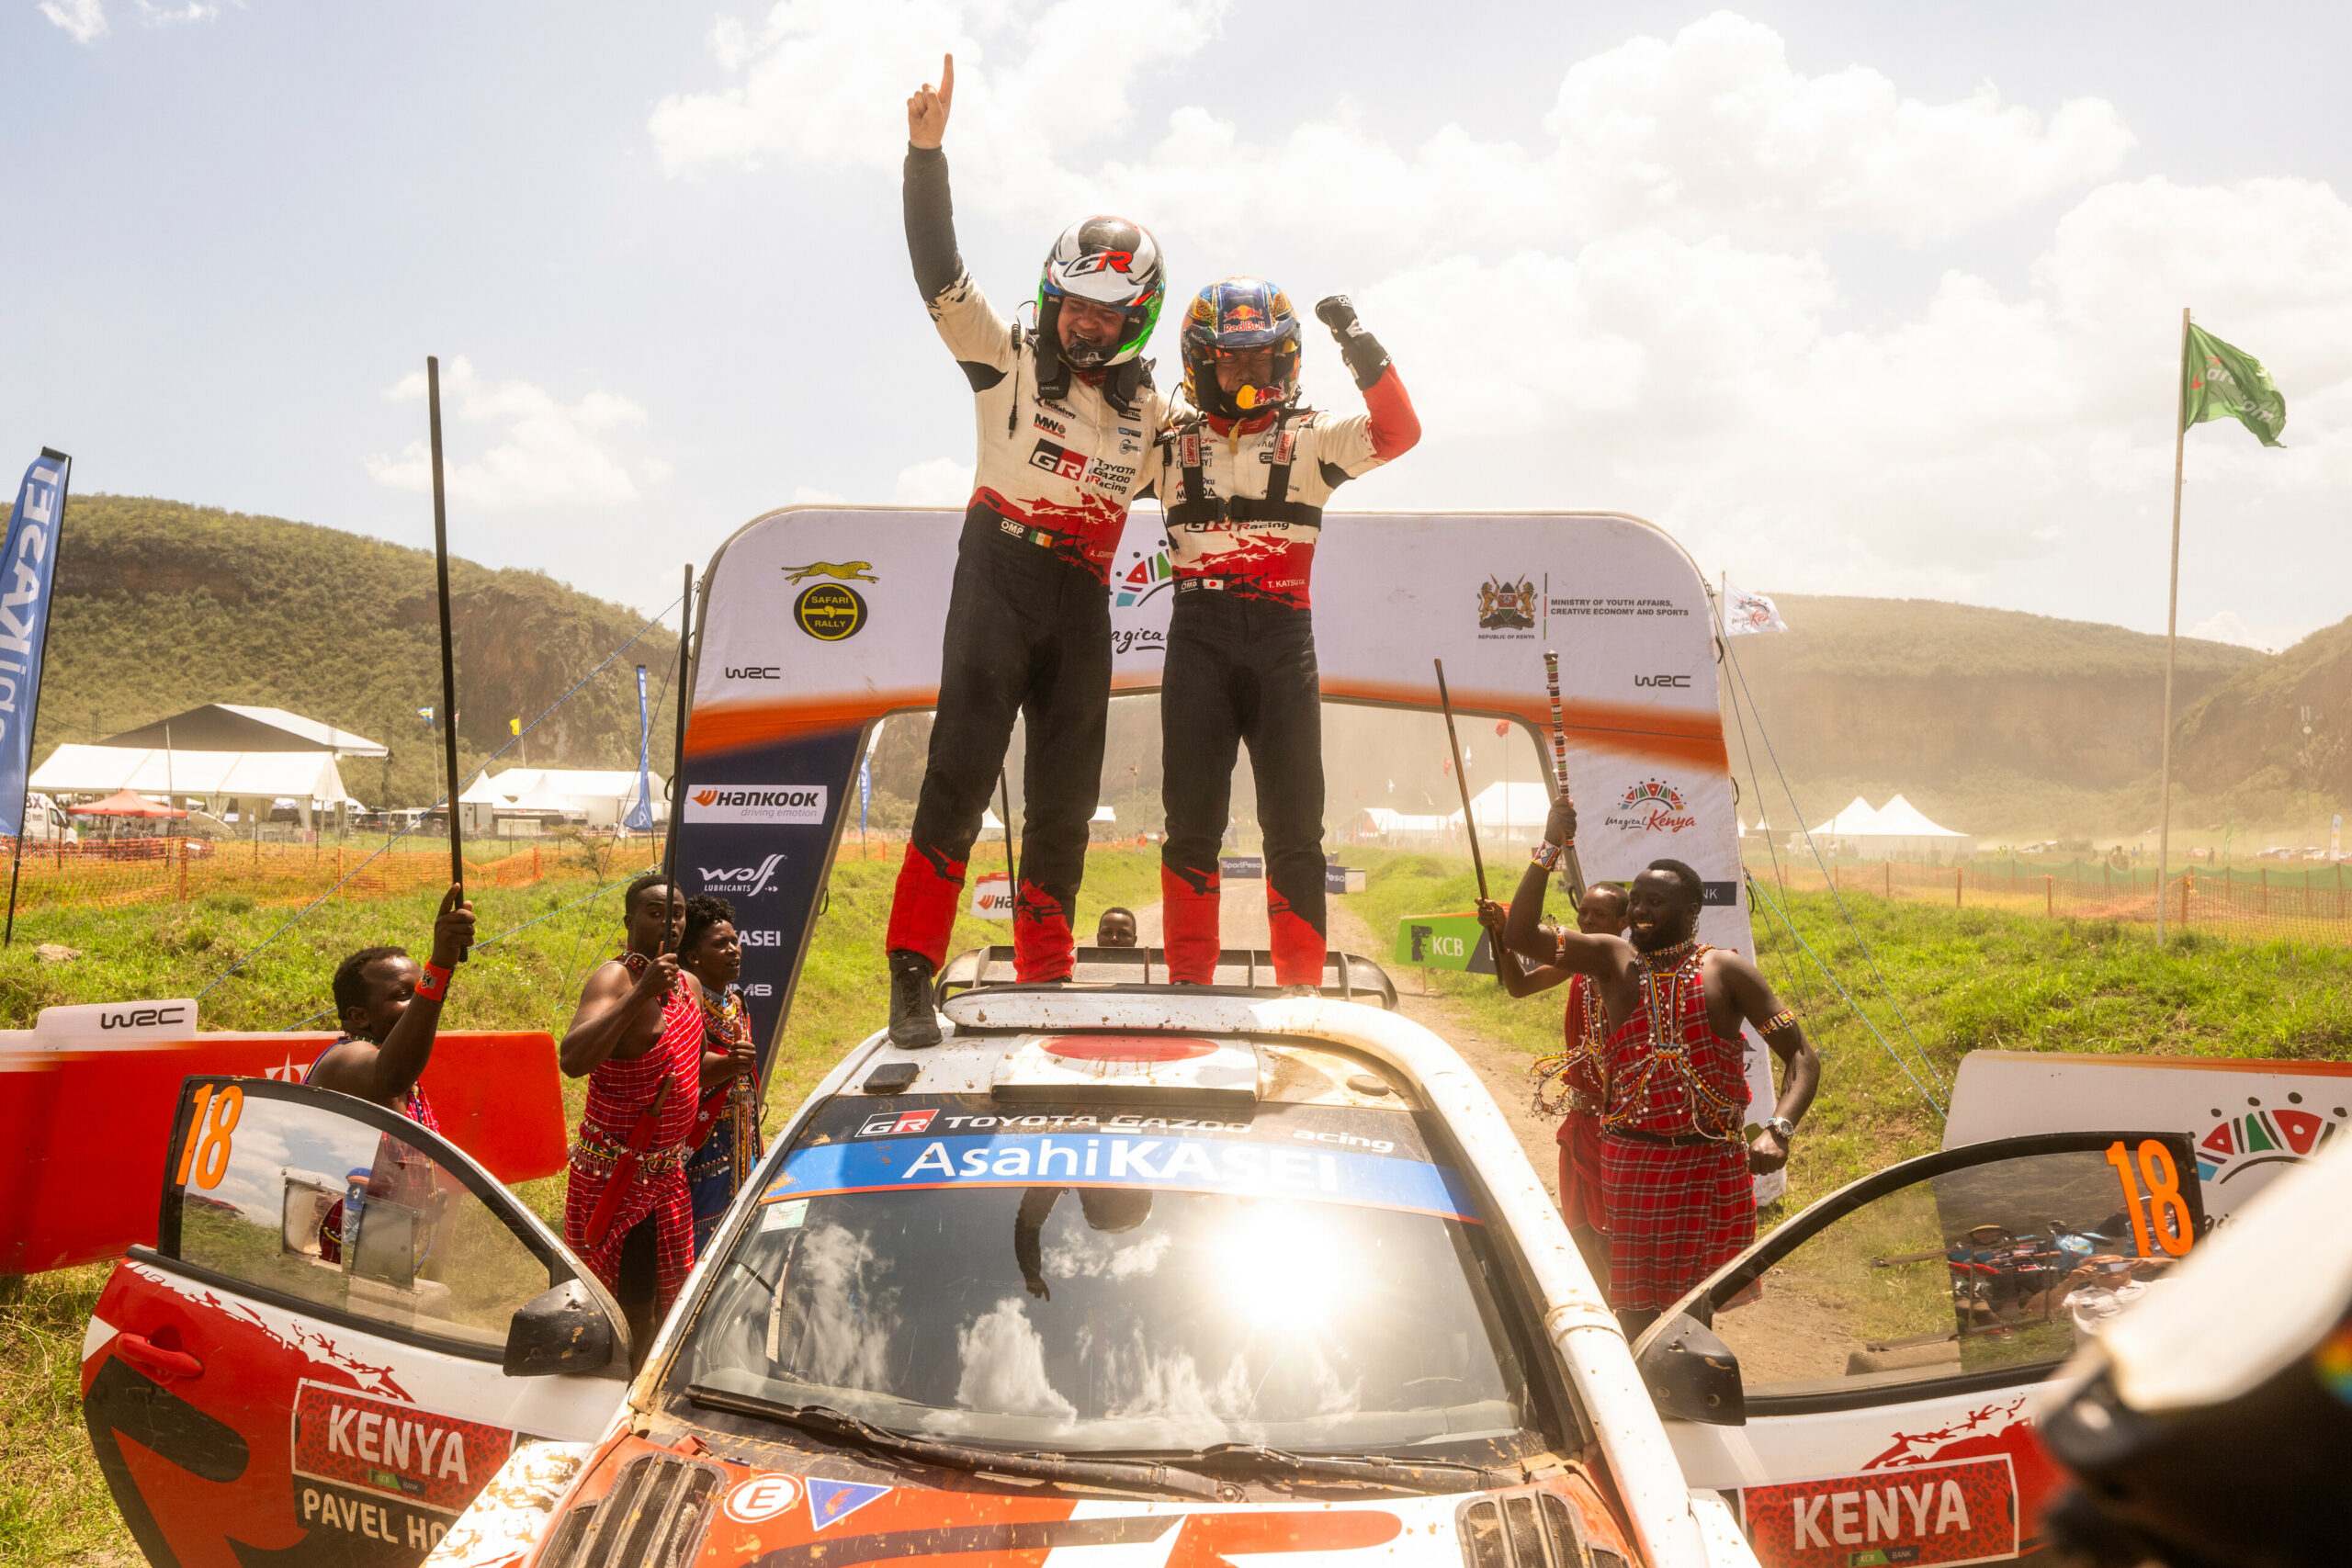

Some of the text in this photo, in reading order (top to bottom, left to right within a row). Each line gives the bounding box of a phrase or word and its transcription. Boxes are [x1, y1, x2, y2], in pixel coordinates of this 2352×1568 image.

[1063, 251, 1133, 277] GR
[1224, 321, 1266, 333] Red Bull
[1032, 450, 1082, 480] GR
[1096, 457, 1136, 476] TOYOTA
[1001, 520, 1024, 536] OMP
[1657, 608, 1689, 616] SPORTS
[1112, 628, 1166, 655] agica
[726, 667, 780, 679] WRC
[1634, 675, 1690, 688] WRC
[741, 808, 817, 818] driving emotion
[1646, 809, 1697, 833] Kenya
[737, 930, 781, 946] ASEI
[1432, 935, 1464, 957] KCB
[101, 1007, 186, 1030] WRC
[862, 1117, 931, 1134] GR
[944, 1115, 1098, 1129] TOYOTA
[1109, 1114, 1252, 1134] GAZOO
[176, 1084, 244, 1190] 18
[2105, 1139, 2194, 1258] 18
[328, 1404, 469, 1484] KENYA
[745, 1486, 781, 1509] E
[302, 1488, 399, 1544] PAVEL
[1793, 1479, 1972, 1551] KENYA
[1892, 1551, 1912, 1560] BANK
